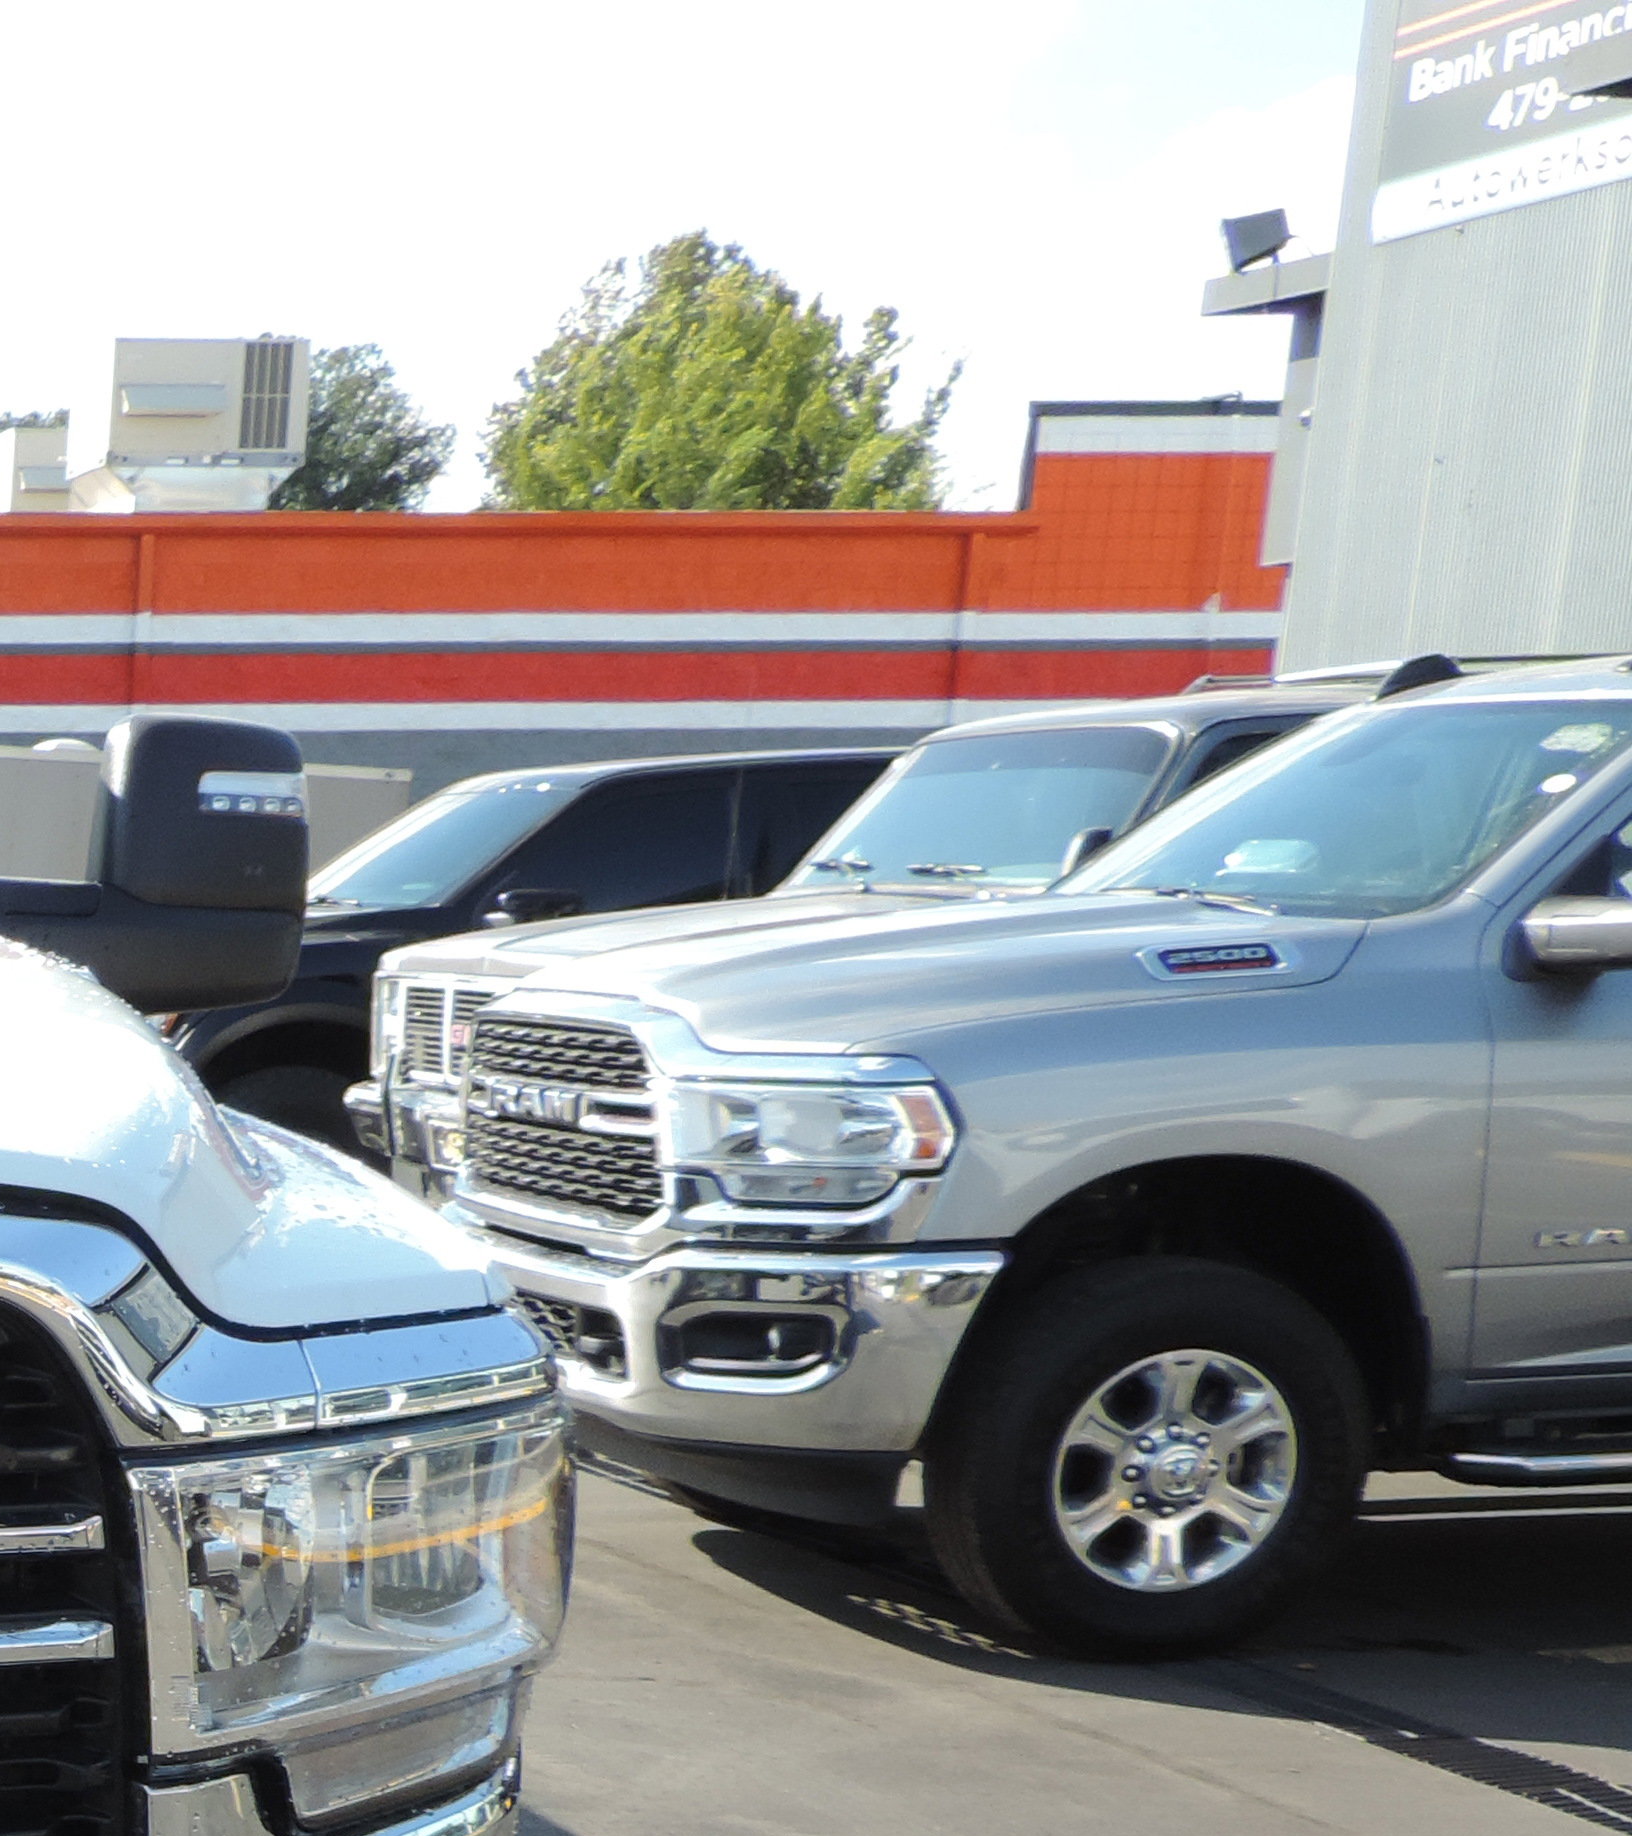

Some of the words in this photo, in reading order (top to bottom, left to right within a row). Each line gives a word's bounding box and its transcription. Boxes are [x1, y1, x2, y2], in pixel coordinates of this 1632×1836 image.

[1409, 40, 1496, 102] Bank
[1167, 947, 1268, 964] 2500
[491, 1082, 578, 1125] RAM
